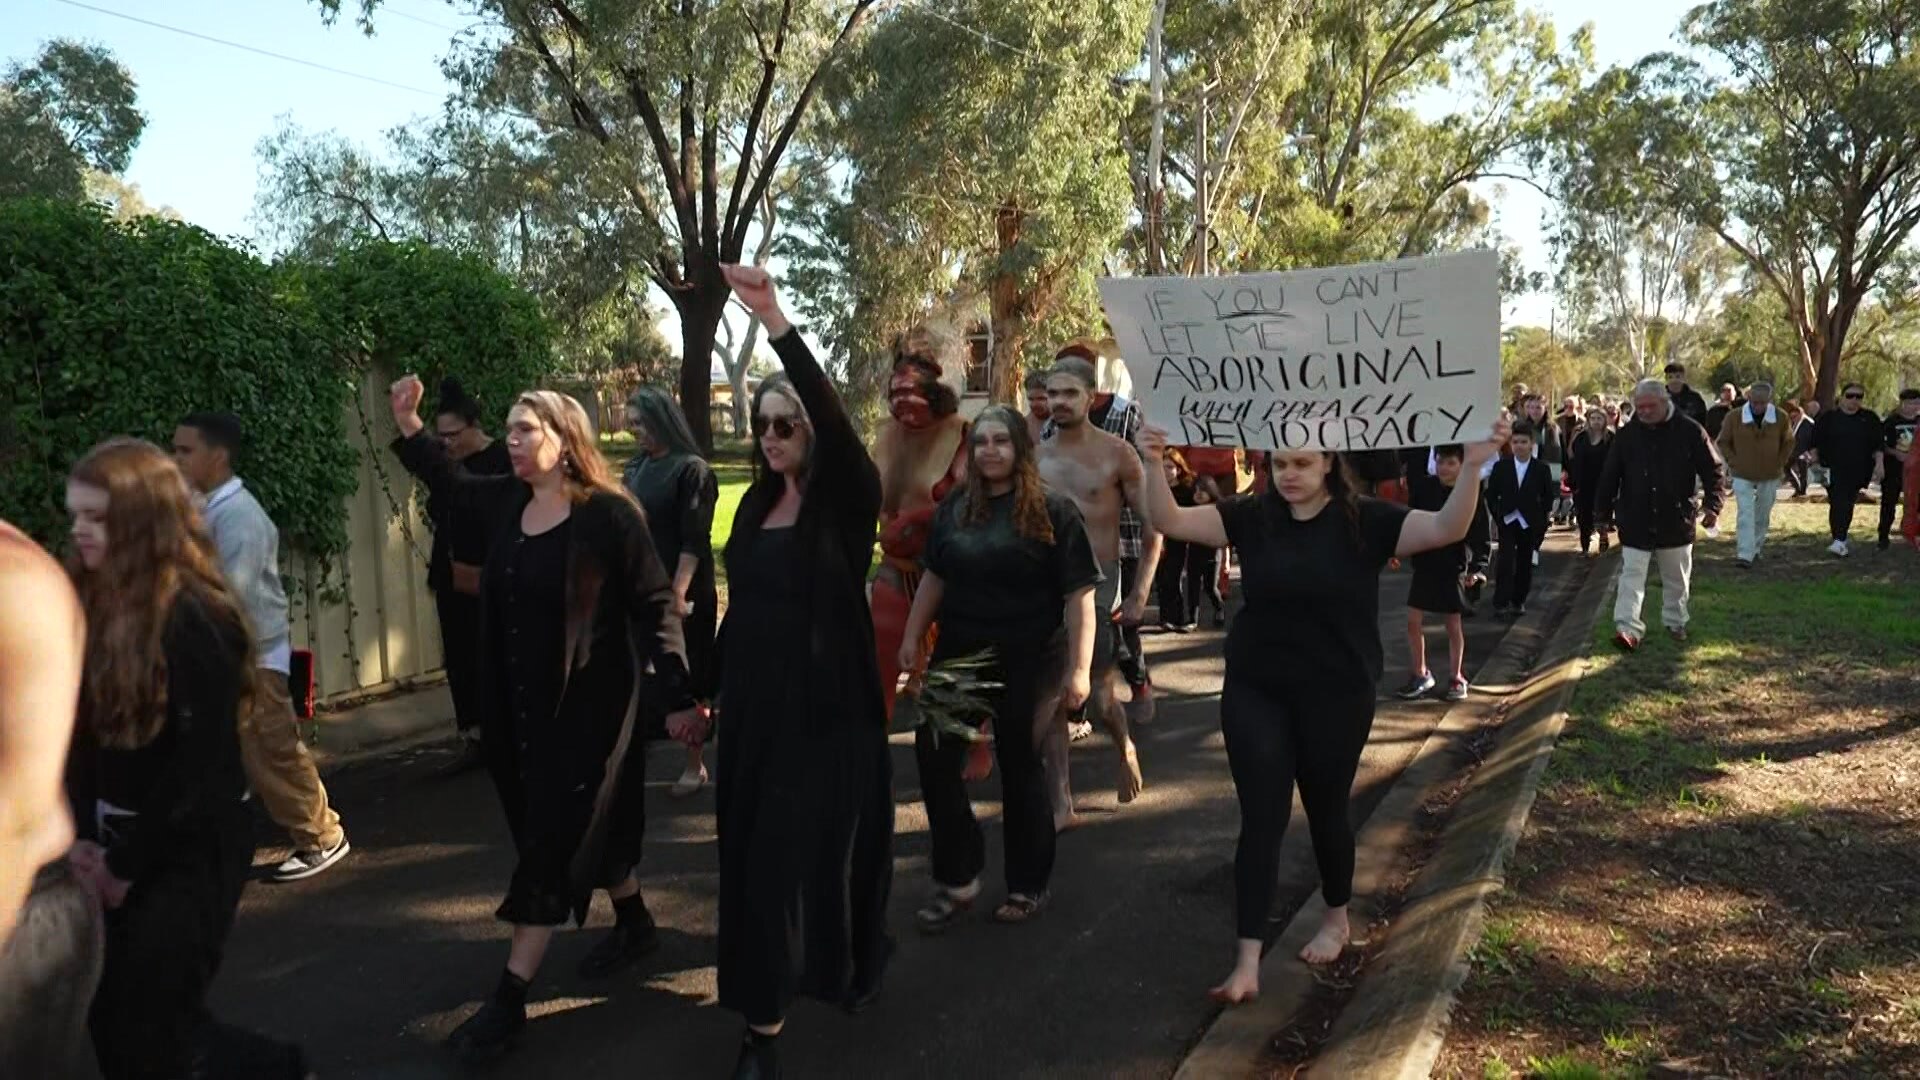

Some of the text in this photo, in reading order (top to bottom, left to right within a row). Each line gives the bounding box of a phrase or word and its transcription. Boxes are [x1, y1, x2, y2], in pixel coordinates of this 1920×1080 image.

[1145, 288, 1173, 321] IF
[1201, 285, 1286, 320] YOU
[1141, 299, 1425, 355] LET ME LIVE
[1152, 339, 1475, 392] ABORIGINAL
[1179, 404, 1474, 451] DEMOCRACY
[1262, 392, 1414, 421] PREACH
